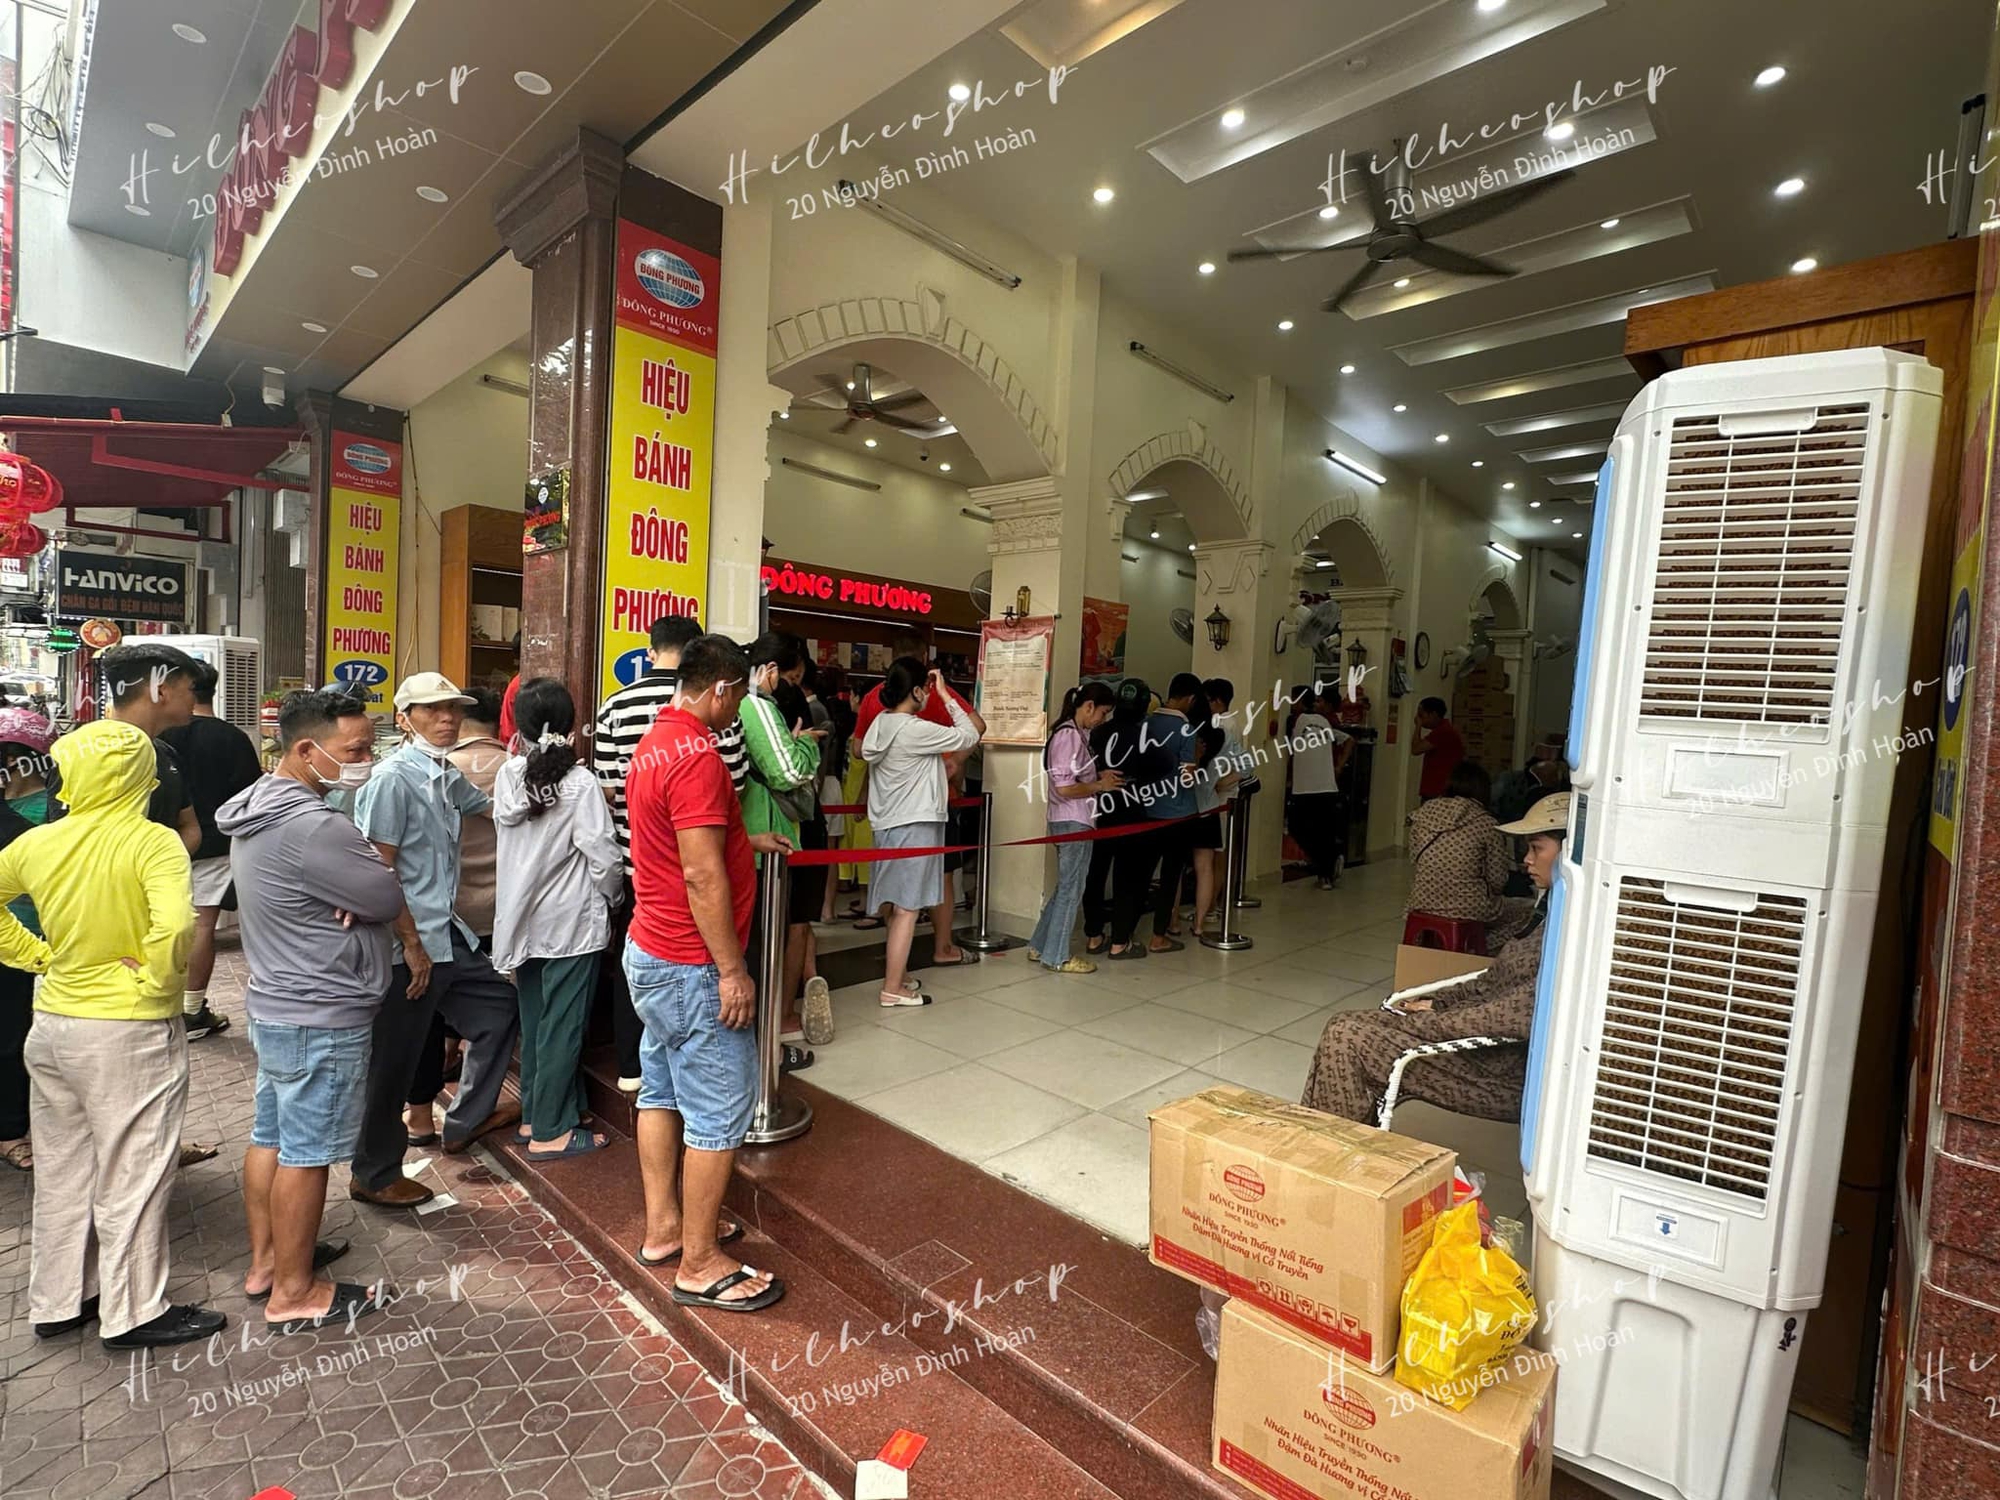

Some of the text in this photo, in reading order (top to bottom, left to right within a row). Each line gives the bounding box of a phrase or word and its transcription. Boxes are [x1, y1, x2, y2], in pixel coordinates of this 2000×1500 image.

[623, 298, 656, 318] ĐÔNG
[641, 359, 691, 420] HIỆU
[633, 432, 692, 491] BÁNH
[350, 502, 382, 535] HIỆU
[630, 508, 688, 564] ĐÔNG
[345, 542, 384, 573] BÁNH
[344, 584, 383, 614] ĐÔNG
[761, 563, 932, 614] ĐÔNG PHƯƠNG
[333, 628, 391, 655] PHƯƠNG
[344, 664, 378, 682] 172
[1209, 1192, 1235, 1210] ĐÔNG
[1250, 1237, 1277, 1257] Thống
[1303, 1408, 1336, 1434] ĐÔNG
[1264, 1416, 1291, 1439] Nhãn
[1292, 1432, 1316, 1453] Hiệu
[1318, 1446, 1353, 1474] Truyền
[1356, 1467, 1389, 1493] Thống
[1323, 1433, 1346, 1450] SINCE
[1303, 1452, 1318, 1468] Đà
[1320, 1462, 1355, 1490] Hương
[1357, 1480, 1368, 1497] vị
